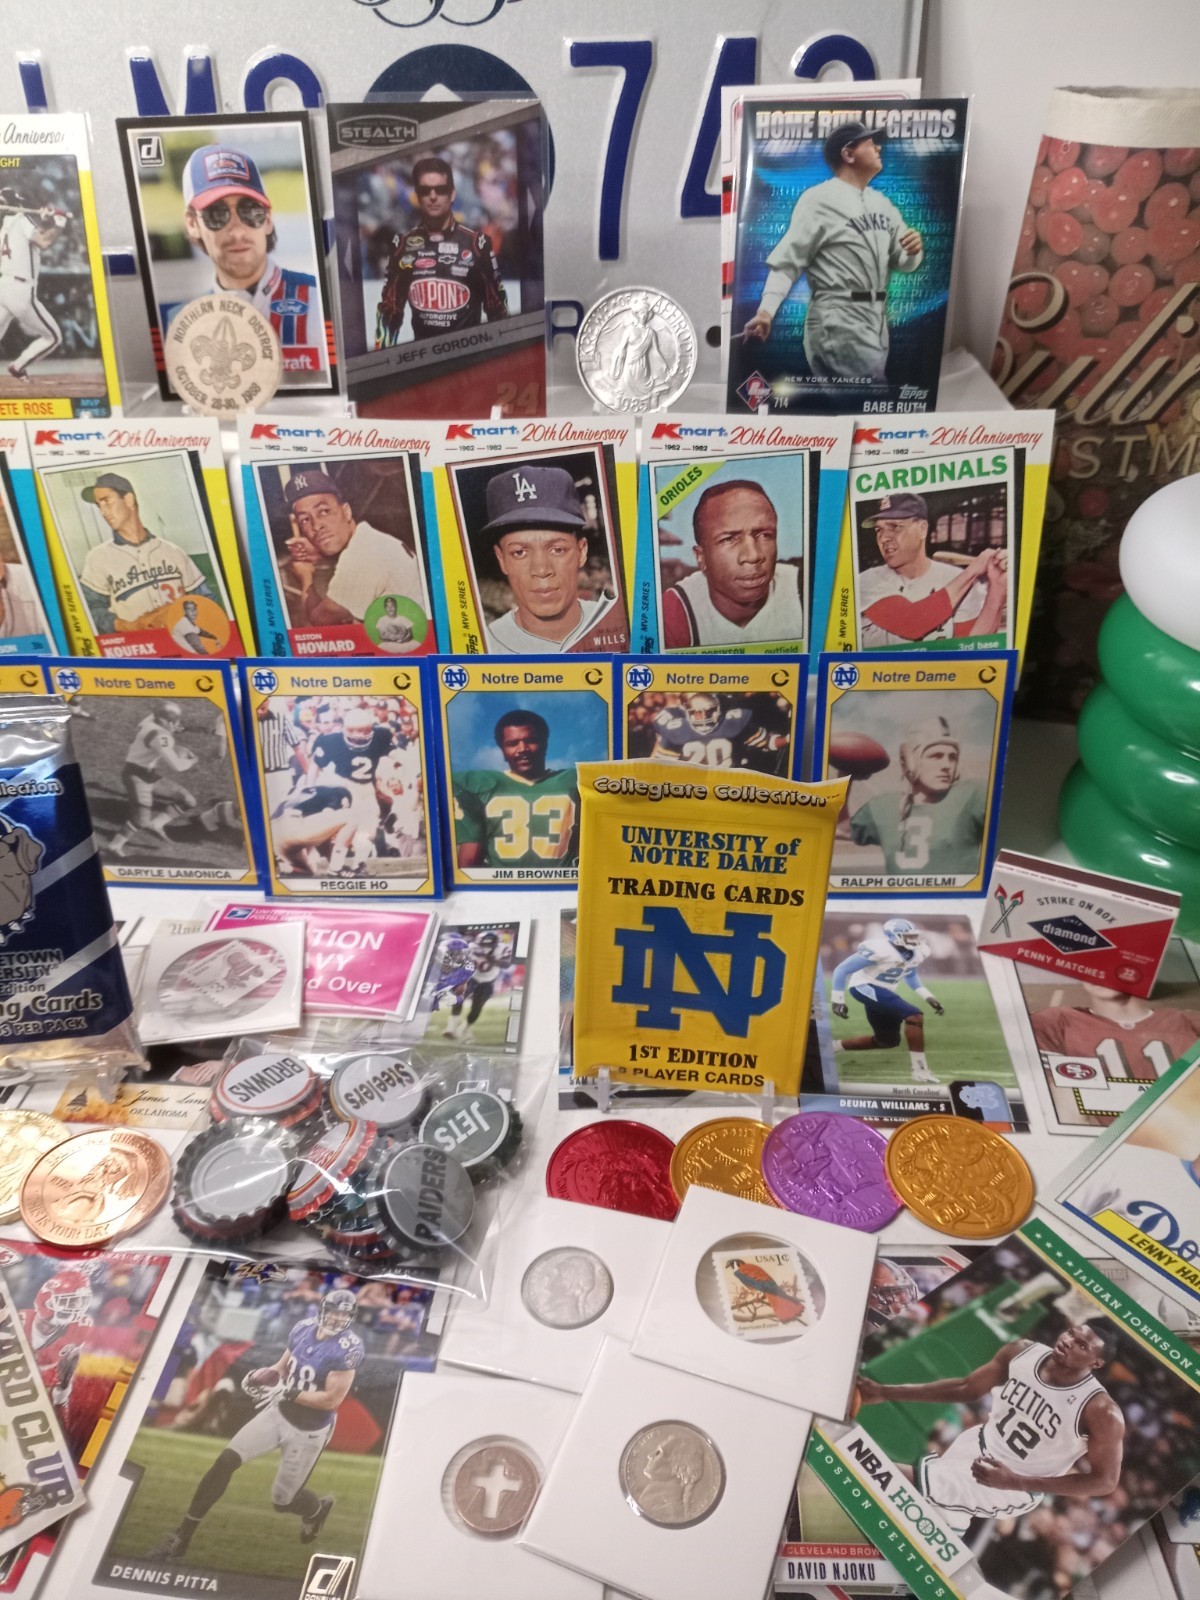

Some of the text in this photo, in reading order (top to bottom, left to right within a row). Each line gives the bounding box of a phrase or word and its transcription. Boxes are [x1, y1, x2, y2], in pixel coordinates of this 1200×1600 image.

[340, 127, 416, 139] STEALTH
[755, 110, 816, 140] HOME
[275, 301, 302, 314] Ford
[173, 299, 274, 361] NORTHERN NECK DISTRICT
[396, 332, 488, 366] JEFF GORDON
[175, 365, 209, 406] OCTOBER
[784, 375, 872, 385] NEW YORK YANKEES
[23, 401, 55, 416] ROSE
[773, 397, 927, 414] 714 BABE RUTH
[34, 427, 211, 454] Kmart 20th Anniversary
[250, 423, 431, 457] Kmart 20th Anniversary
[445, 421, 629, 447] Kmart 20th Anniversary
[651, 423, 839, 455] Kmart 20th Anniversary
[853, 424, 1044, 450] Kmart 20th Anniversary
[659, 466, 703, 506] ORIOLES
[855, 454, 1008, 494] CARDINALS
[512, 473, 537, 503] LA
[63, 584, 83, 633] MVP SERIES
[262, 578, 276, 627] MVP SERIES
[457, 580, 470, 630] MVP SERIES
[640, 581, 650, 632] MVP SERIES
[840, 588, 850, 618] SERIES
[101, 637, 125, 645] SANDY
[295, 633, 322, 641] ELSTON
[593, 633, 627, 646] WILLS
[839, 619, 848, 638] MVP
[105, 643, 157, 658] KOUFAX
[297, 639, 356, 654] HOWARD
[957, 640, 999, 651] 3rd base
[94, 677, 175, 690] Notre Dame
[290, 675, 373, 688] Notre Dame
[481, 672, 563, 684] Notre Dame
[666, 672, 749, 685] Notre Dame
[872, 670, 957, 683] Notre Dame
[593, 777, 827, 807] Collegiate Collection
[485, 794, 576, 859] 33
[621, 825, 802, 857] UNIVERSITY of
[894, 816, 933, 869] 3
[118, 867, 232, 879] DARYLE LAMONICA
[629, 845, 788, 875] NOTRE DAME
[320, 880, 388, 890] REGGIE HO
[492, 869, 578, 879] JIM BROWNER
[841, 876, 956, 887] RALPH GUGLIELMI
[608, 877, 805, 907] TRADING CARDS
[1036, 895, 1118, 924] STRIKE ON BOX
[466, 922, 511, 931] OAKLAND
[1042, 923, 1097, 946] diamond
[1017, 947, 1106, 979] PENNY MATCHES
[328, 976, 382, 996] Over
[31, 989, 102, 1014] Cards
[13, 1017, 87, 1035] PER PACK
[629, 1044, 758, 1069] 1ST EDITION
[227, 1056, 305, 1103] BROWNS
[343, 1061, 415, 1111] Steelers
[633, 1066, 765, 1087] PLAYER CARDS
[892, 1087, 940, 1096] North Carolina
[130, 1107, 188, 1118] OKLAHOMA
[839, 1099, 946, 1112] DEUNTA WILLIAMS S
[434, 1100, 491, 1151] JETS
[754, 1255, 775, 1263] USA
[1126, 1232, 1177, 1268] LENNY
[1122, 1310, 1193, 1370] JOHNSON
[1000, 1377, 1061, 1440] CELTICS
[995, 1407, 1041, 1461] 12
[11, 1409, 76, 1508] CLUB
[847, 1437, 960, 1563] NBA HOOPS
[815, 1444, 945, 1598] BOSTON CELTICS
[787, 1546, 847, 1556] CLEVELAND
[109, 1564, 218, 1592] DENNIS PITTA
[788, 1562, 876, 1581] DAVID NJOKU
